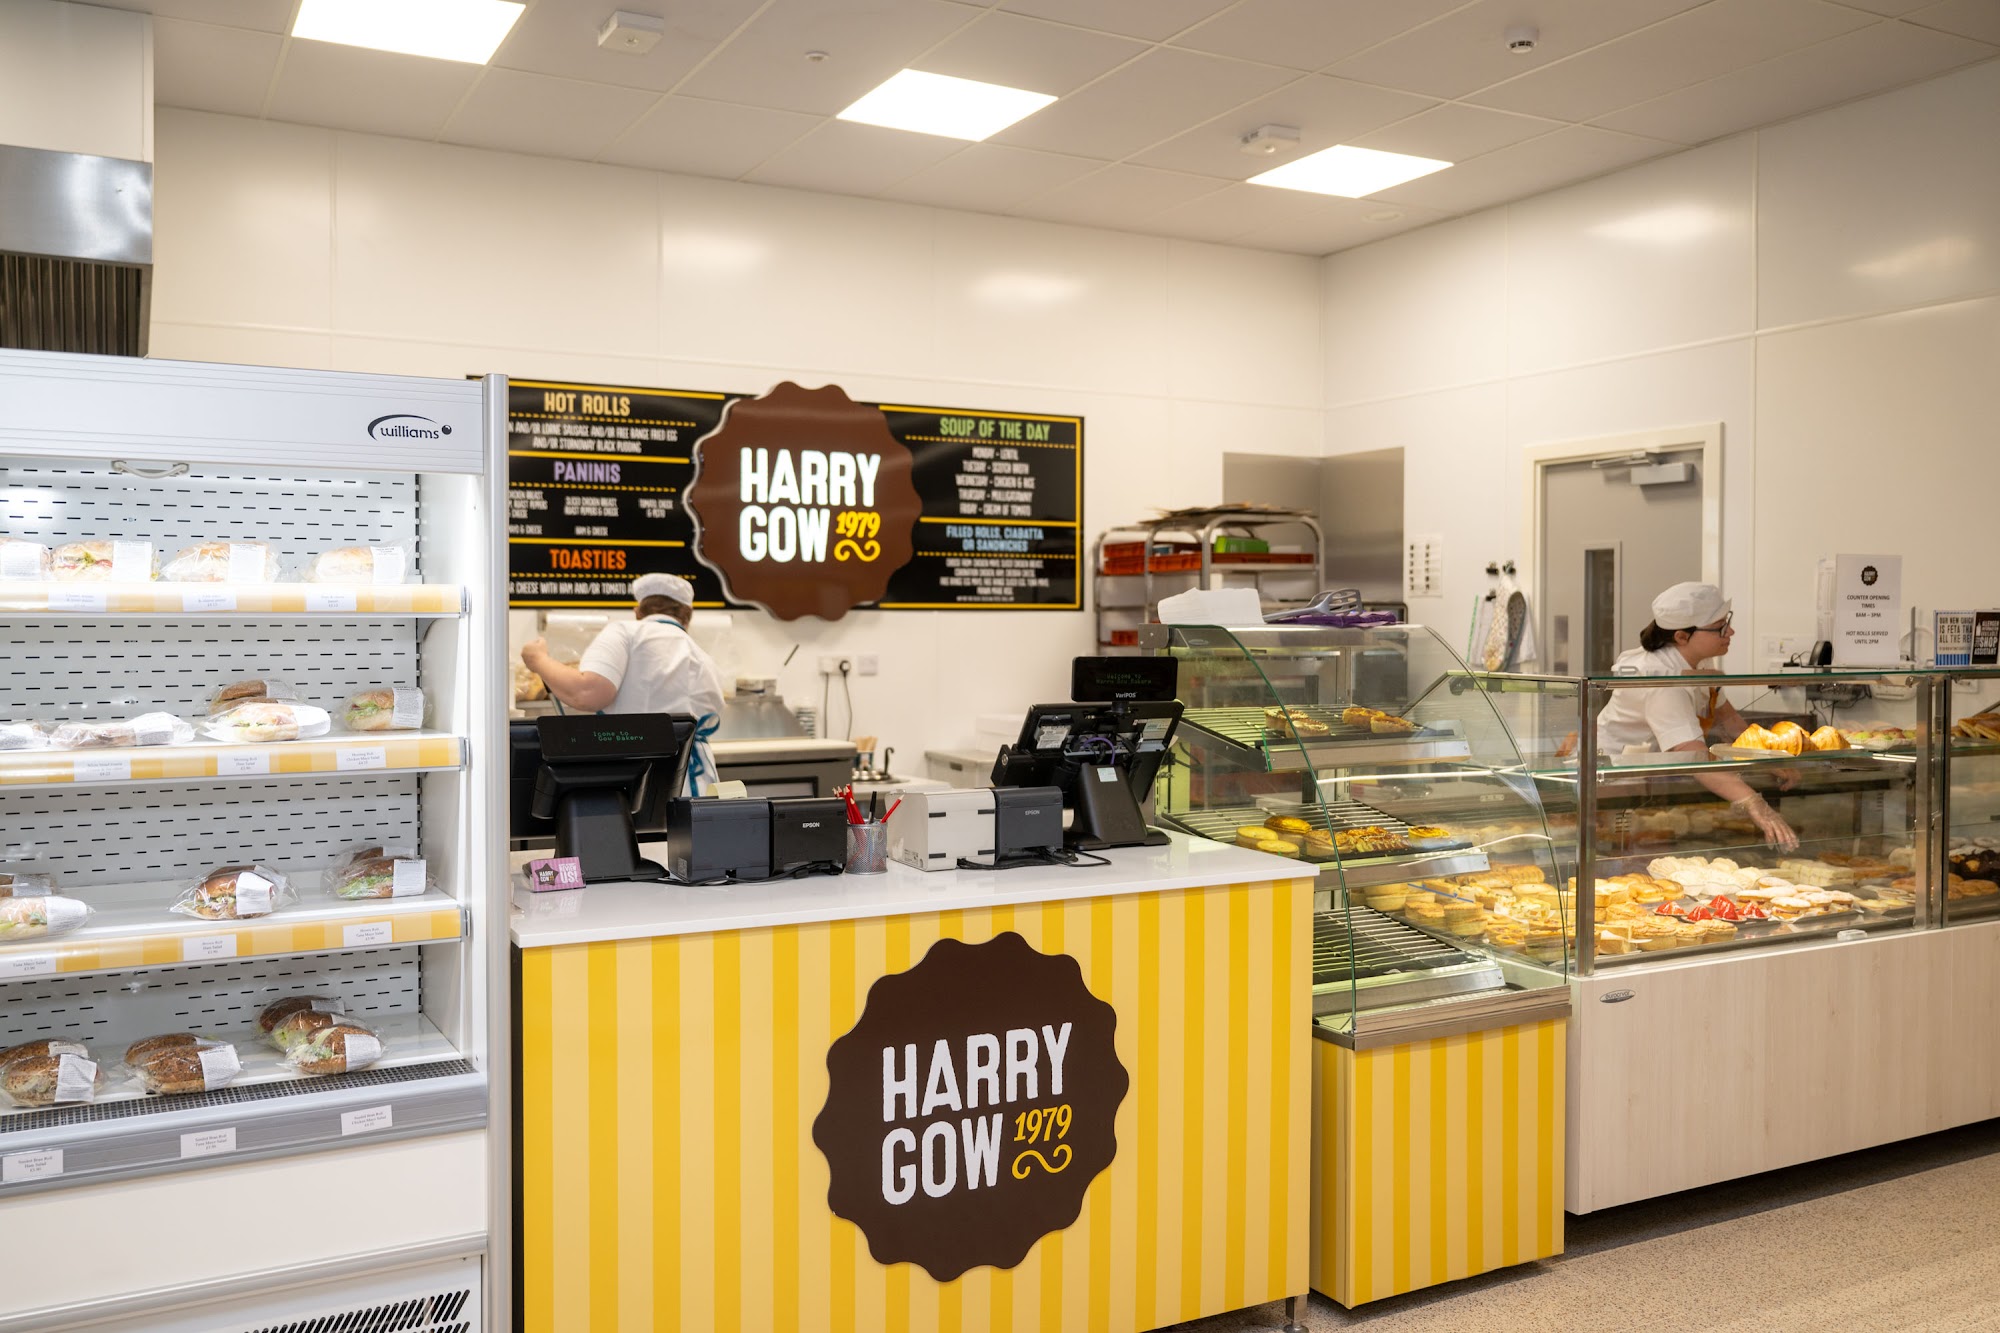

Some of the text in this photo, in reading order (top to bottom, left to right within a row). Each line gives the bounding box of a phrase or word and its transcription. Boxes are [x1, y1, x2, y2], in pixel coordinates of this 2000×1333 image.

[544, 392, 630, 416] HOT ROLLS
[380, 425, 440, 439] williams
[940, 417, 1050, 442] SOUP OF THE DAY
[554, 460, 621, 484] PANINIS
[740, 447, 881, 507] HARRY
[740, 505, 881, 563] GOW 1979
[946, 525, 973, 538] FILLED
[1004, 527, 1044, 540] CIABATTA
[976, 539, 1028, 552] SANDWICHES
[550, 549, 626, 570] TOASTIES
[1939, 635, 1948, 643] ALL
[1951, 635, 1960, 643] THE
[1940, 625, 1945, 633] IS
[1948, 625, 1960, 633] FETA
[1980, 636, 1998, 648] SHOP
[561, 871, 579, 884] US!
[882, 1022, 1072, 1122] HARRY
[882, 1104, 1073, 1205] GOW 1979
